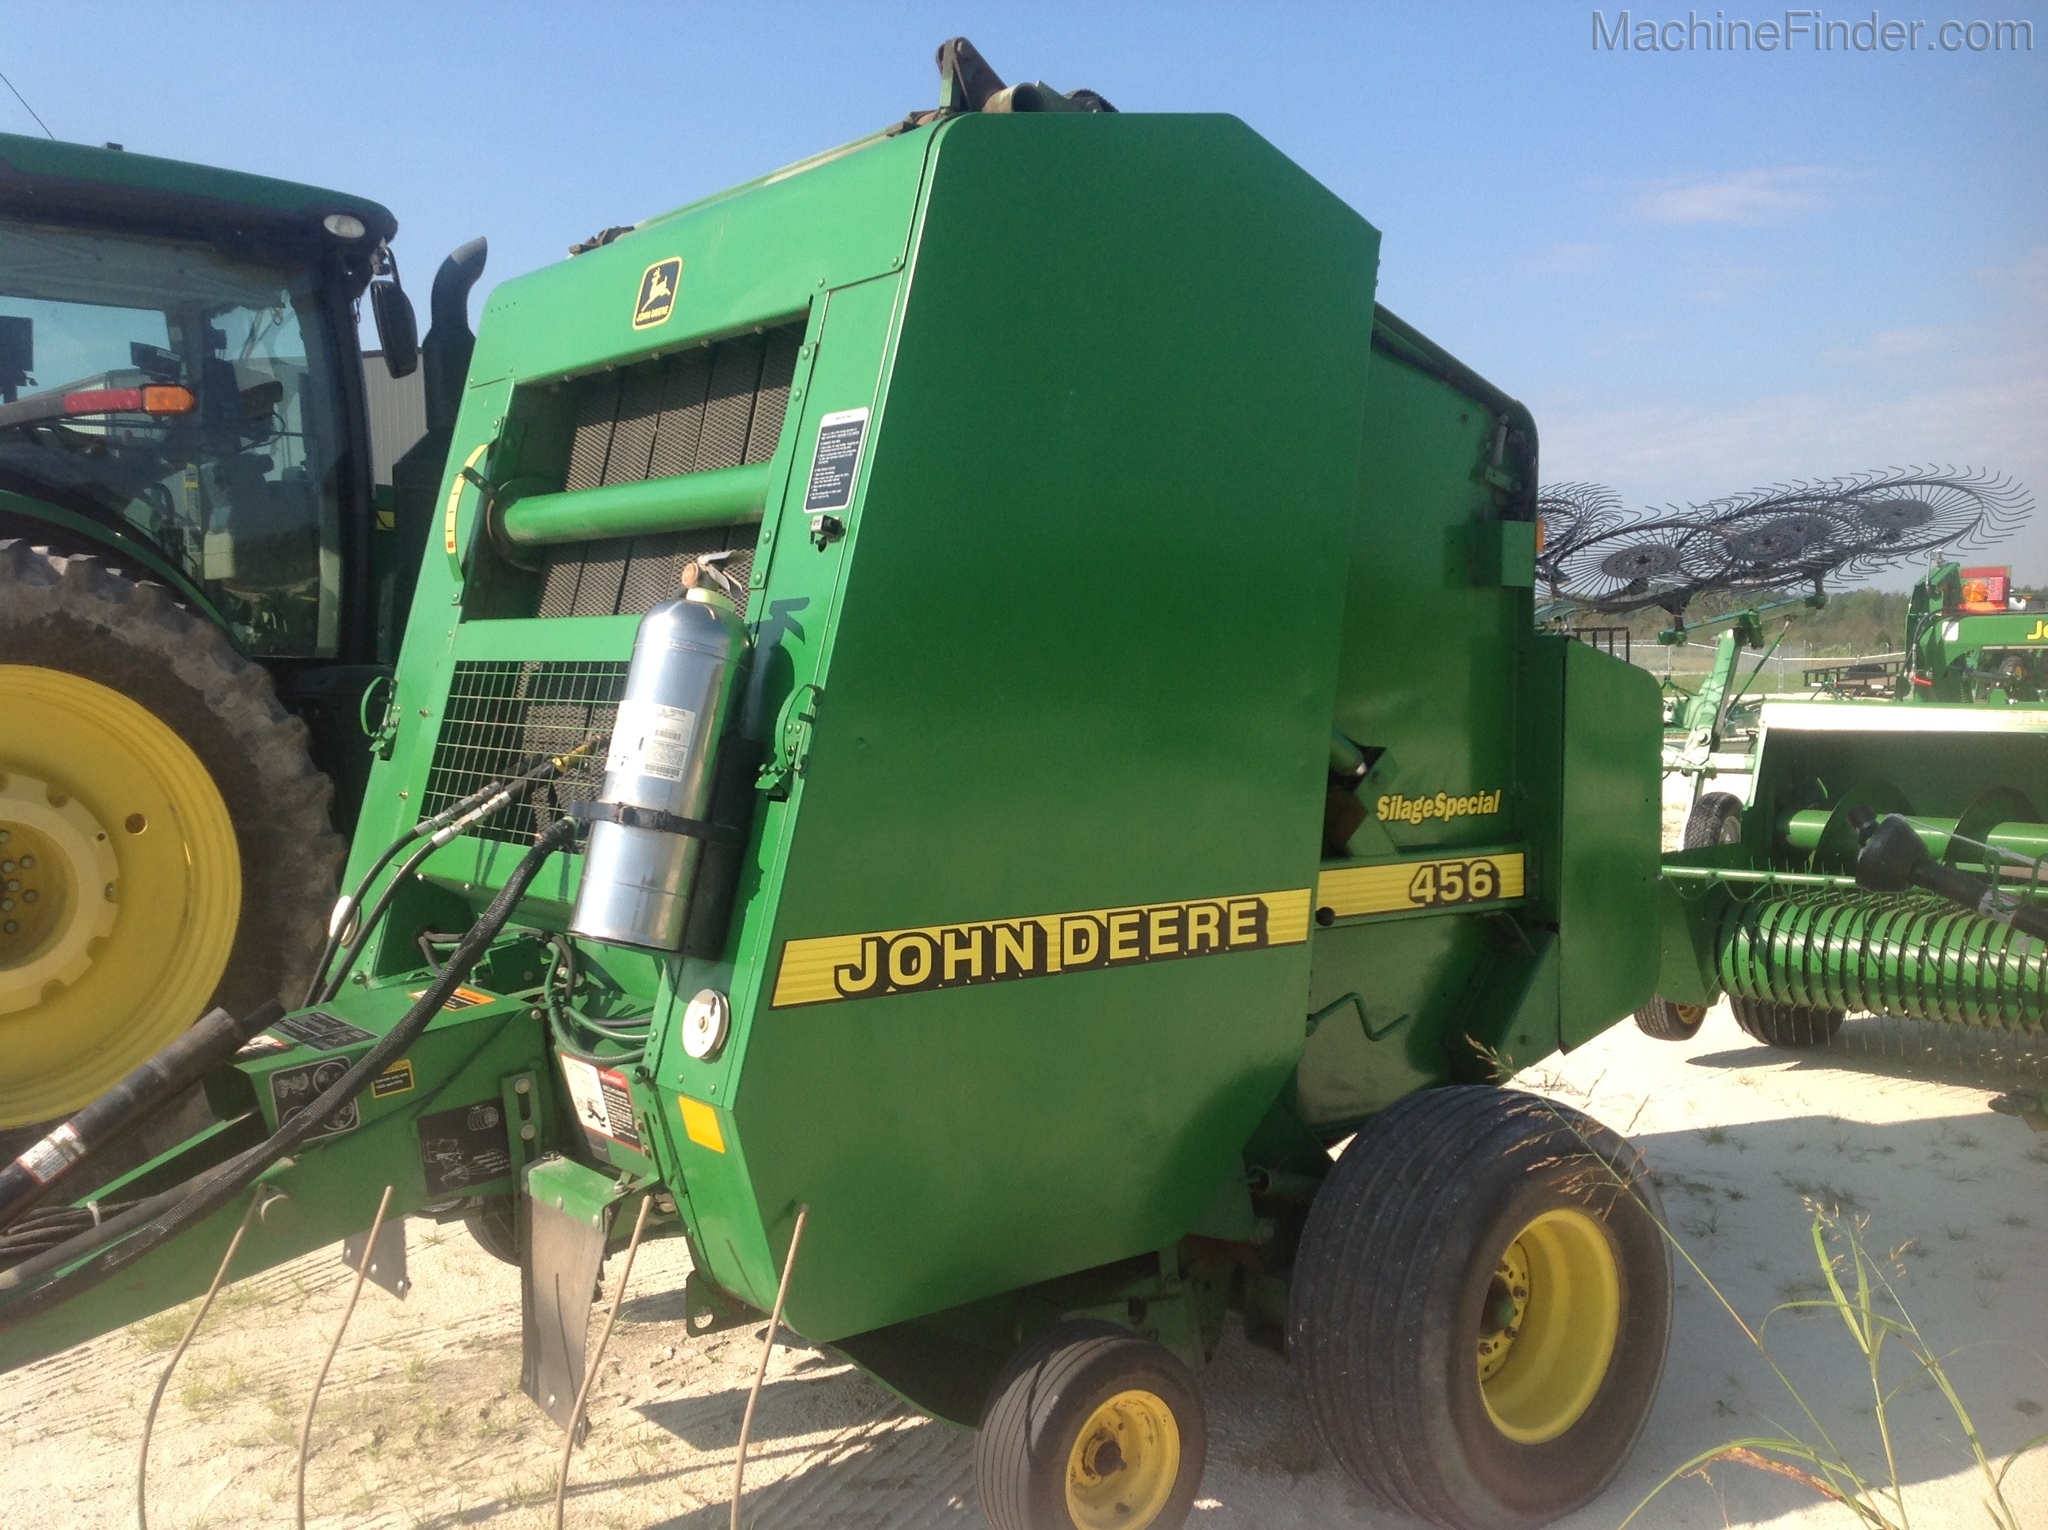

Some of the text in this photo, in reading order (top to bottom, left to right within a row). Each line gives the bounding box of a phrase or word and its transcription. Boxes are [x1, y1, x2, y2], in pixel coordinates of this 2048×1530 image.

[1376, 789, 1501, 825] SilageSpecial
[1410, 862, 1494, 903] 456
[833, 899, 1260, 994] JOHN DEERE
